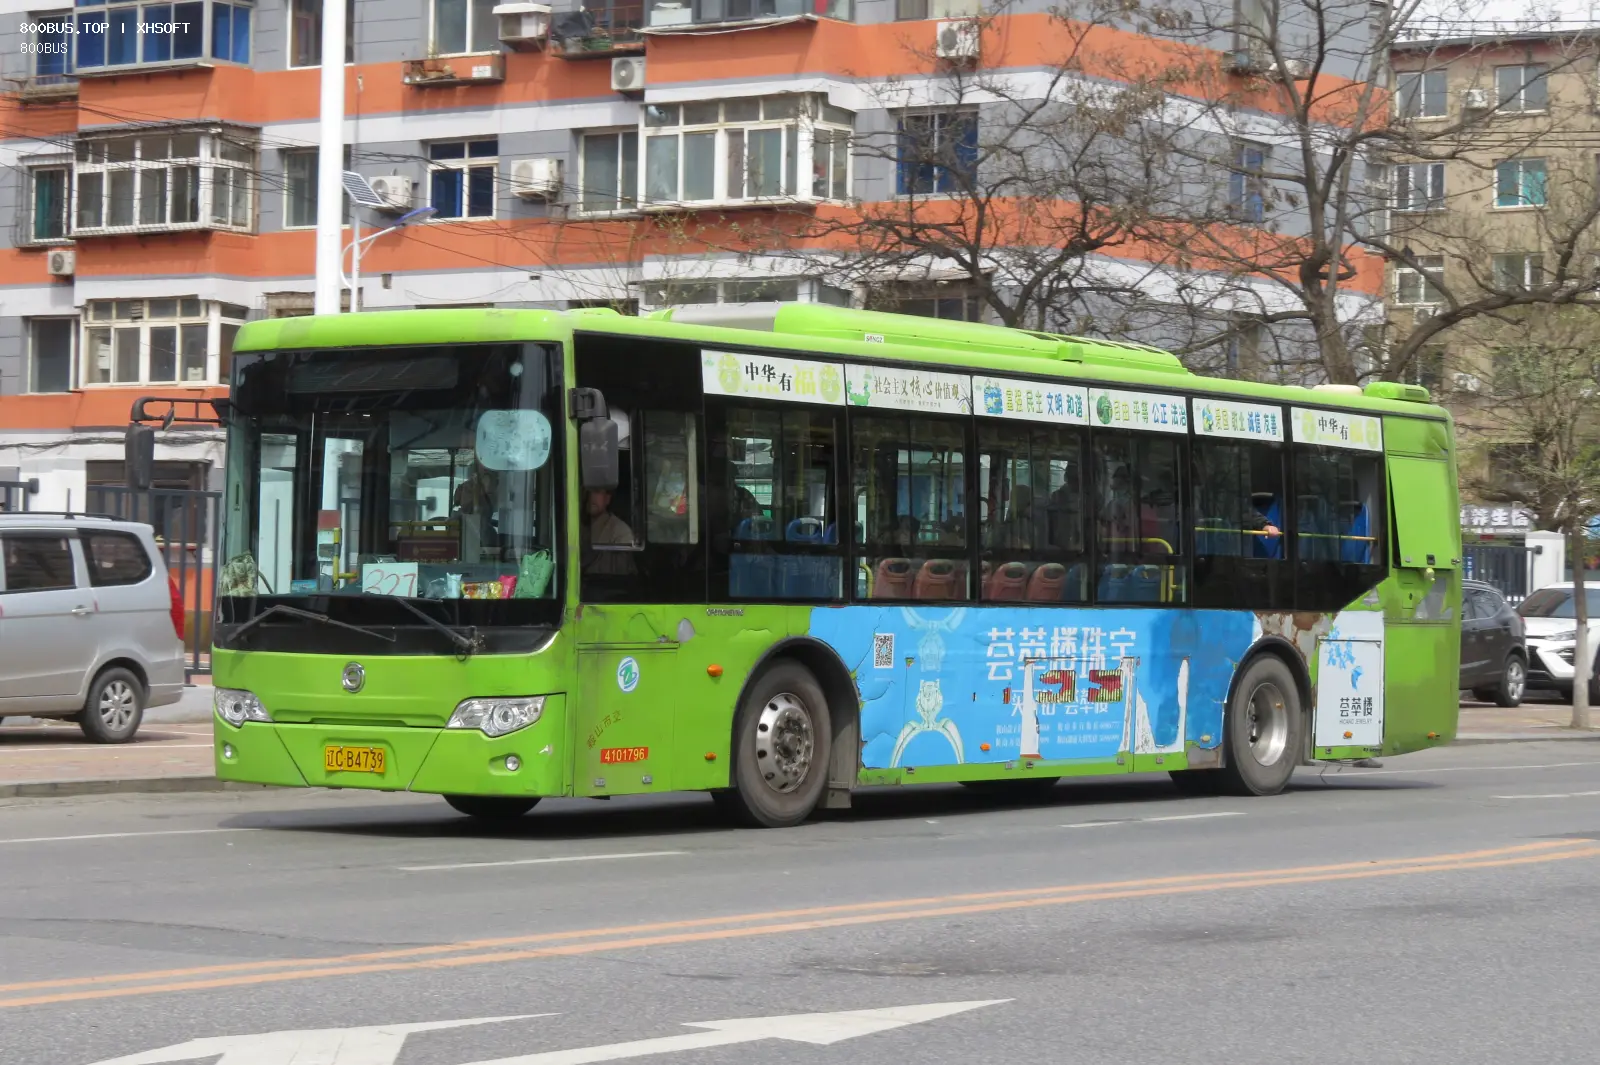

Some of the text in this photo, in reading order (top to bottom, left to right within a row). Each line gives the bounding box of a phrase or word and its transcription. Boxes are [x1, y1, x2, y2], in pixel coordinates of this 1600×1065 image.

[874, 376, 960, 400] 社会主义核心价值观
[1340, 697, 1373, 717] 荟萃楼
[604, 748, 646, 762] 4101796
